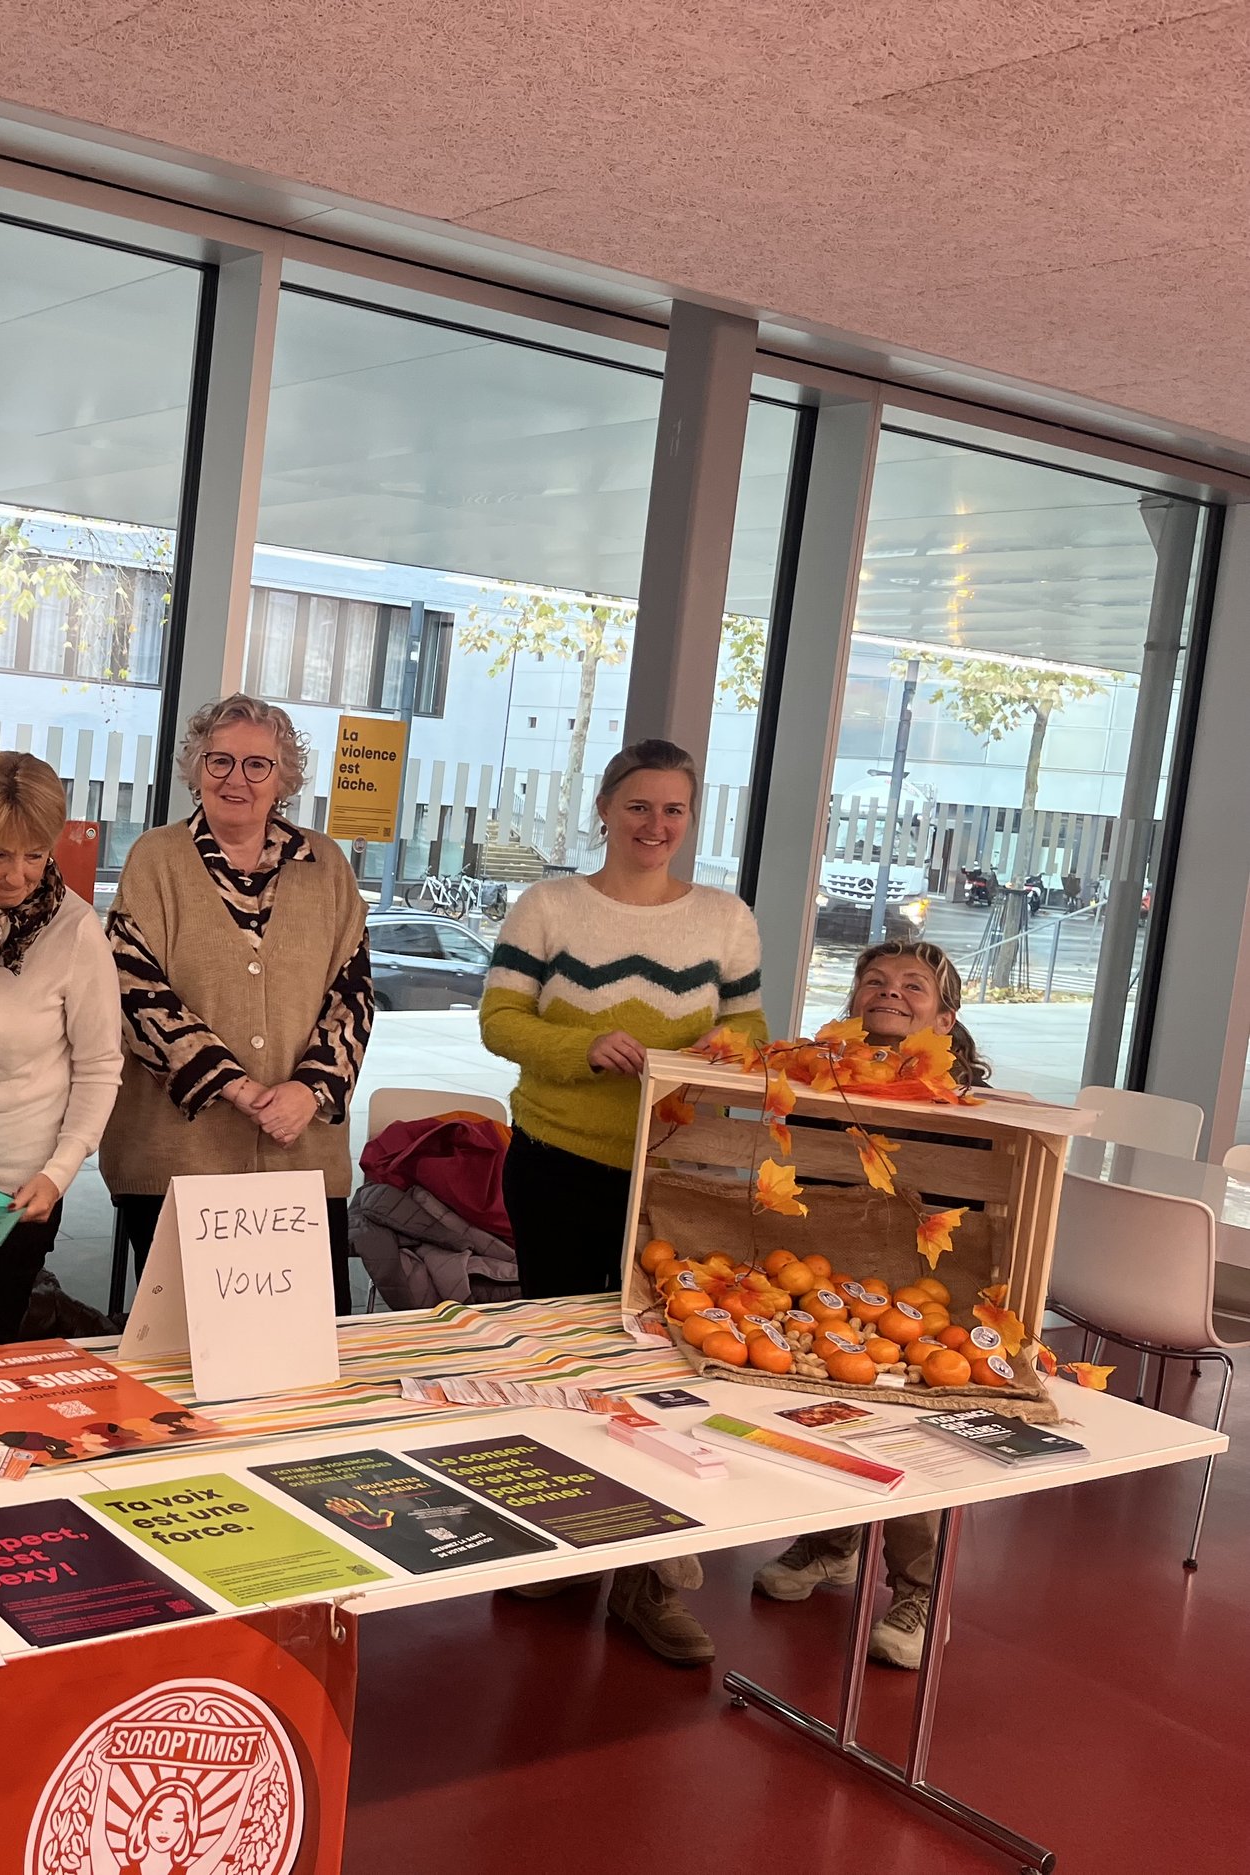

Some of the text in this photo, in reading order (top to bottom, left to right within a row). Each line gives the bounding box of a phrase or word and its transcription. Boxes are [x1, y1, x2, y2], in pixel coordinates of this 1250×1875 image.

[342, 728, 359, 742] La
[341, 744, 397, 762] violence
[339, 762, 360, 774] est
[337, 776, 378, 792] lâche.
[215, 1266, 293, 1300] VOUS
[27, 1366, 119, 1390] SIGNS
[0, 1396, 17, 1405] la
[17, 1383, 117, 1403] cyberviolence
[923, 1409, 995, 1425] VIOLENCE
[428, 1445, 540, 1467] Le consen-
[270, 1457, 375, 1476] VICTIME DE VIOLENCES
[334, 1461, 393, 1474] PSYCHIQUES
[447, 1457, 535, 1477] tement,
[519, 1466, 550, 1478] en
[288, 1479, 303, 1488] OU
[304, 1473, 356, 1486] SEXUELLES
[353, 1481, 385, 1492] VOUS
[485, 1471, 596, 1499] parler. Pas
[104, 1488, 224, 1514] Ta voix
[368, 1488, 391, 1497] PAS
[505, 1486, 593, 1508] deviner.
[132, 1502, 250, 1529] est une
[151, 1522, 255, 1545] force.
[111, 1728, 258, 1763] SOROPTIMIST
